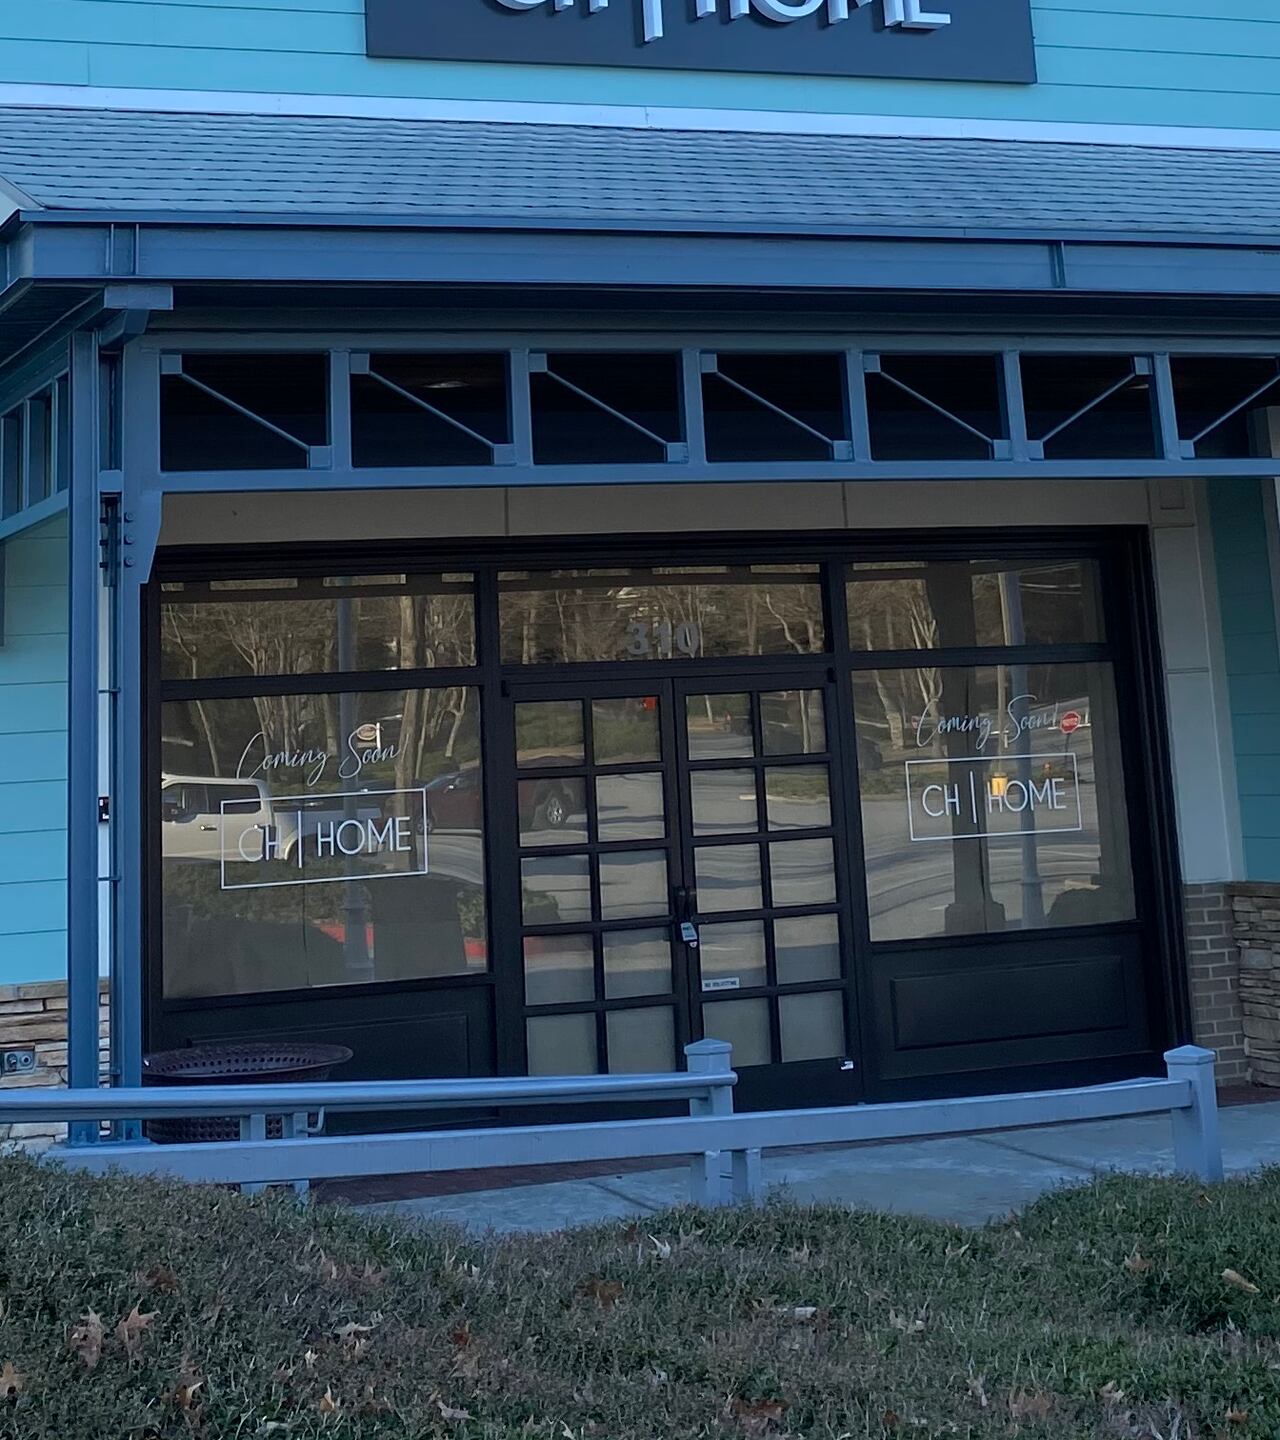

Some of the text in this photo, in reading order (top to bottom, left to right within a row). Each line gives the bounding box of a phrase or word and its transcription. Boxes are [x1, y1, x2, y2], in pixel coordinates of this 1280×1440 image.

[625, 622, 699, 655] 310
[916, 697, 993, 750] Coming
[236, 731, 330, 787] Coming
[922, 777, 1068, 817] CH HOME
[238, 816, 412, 863] CH HOME
